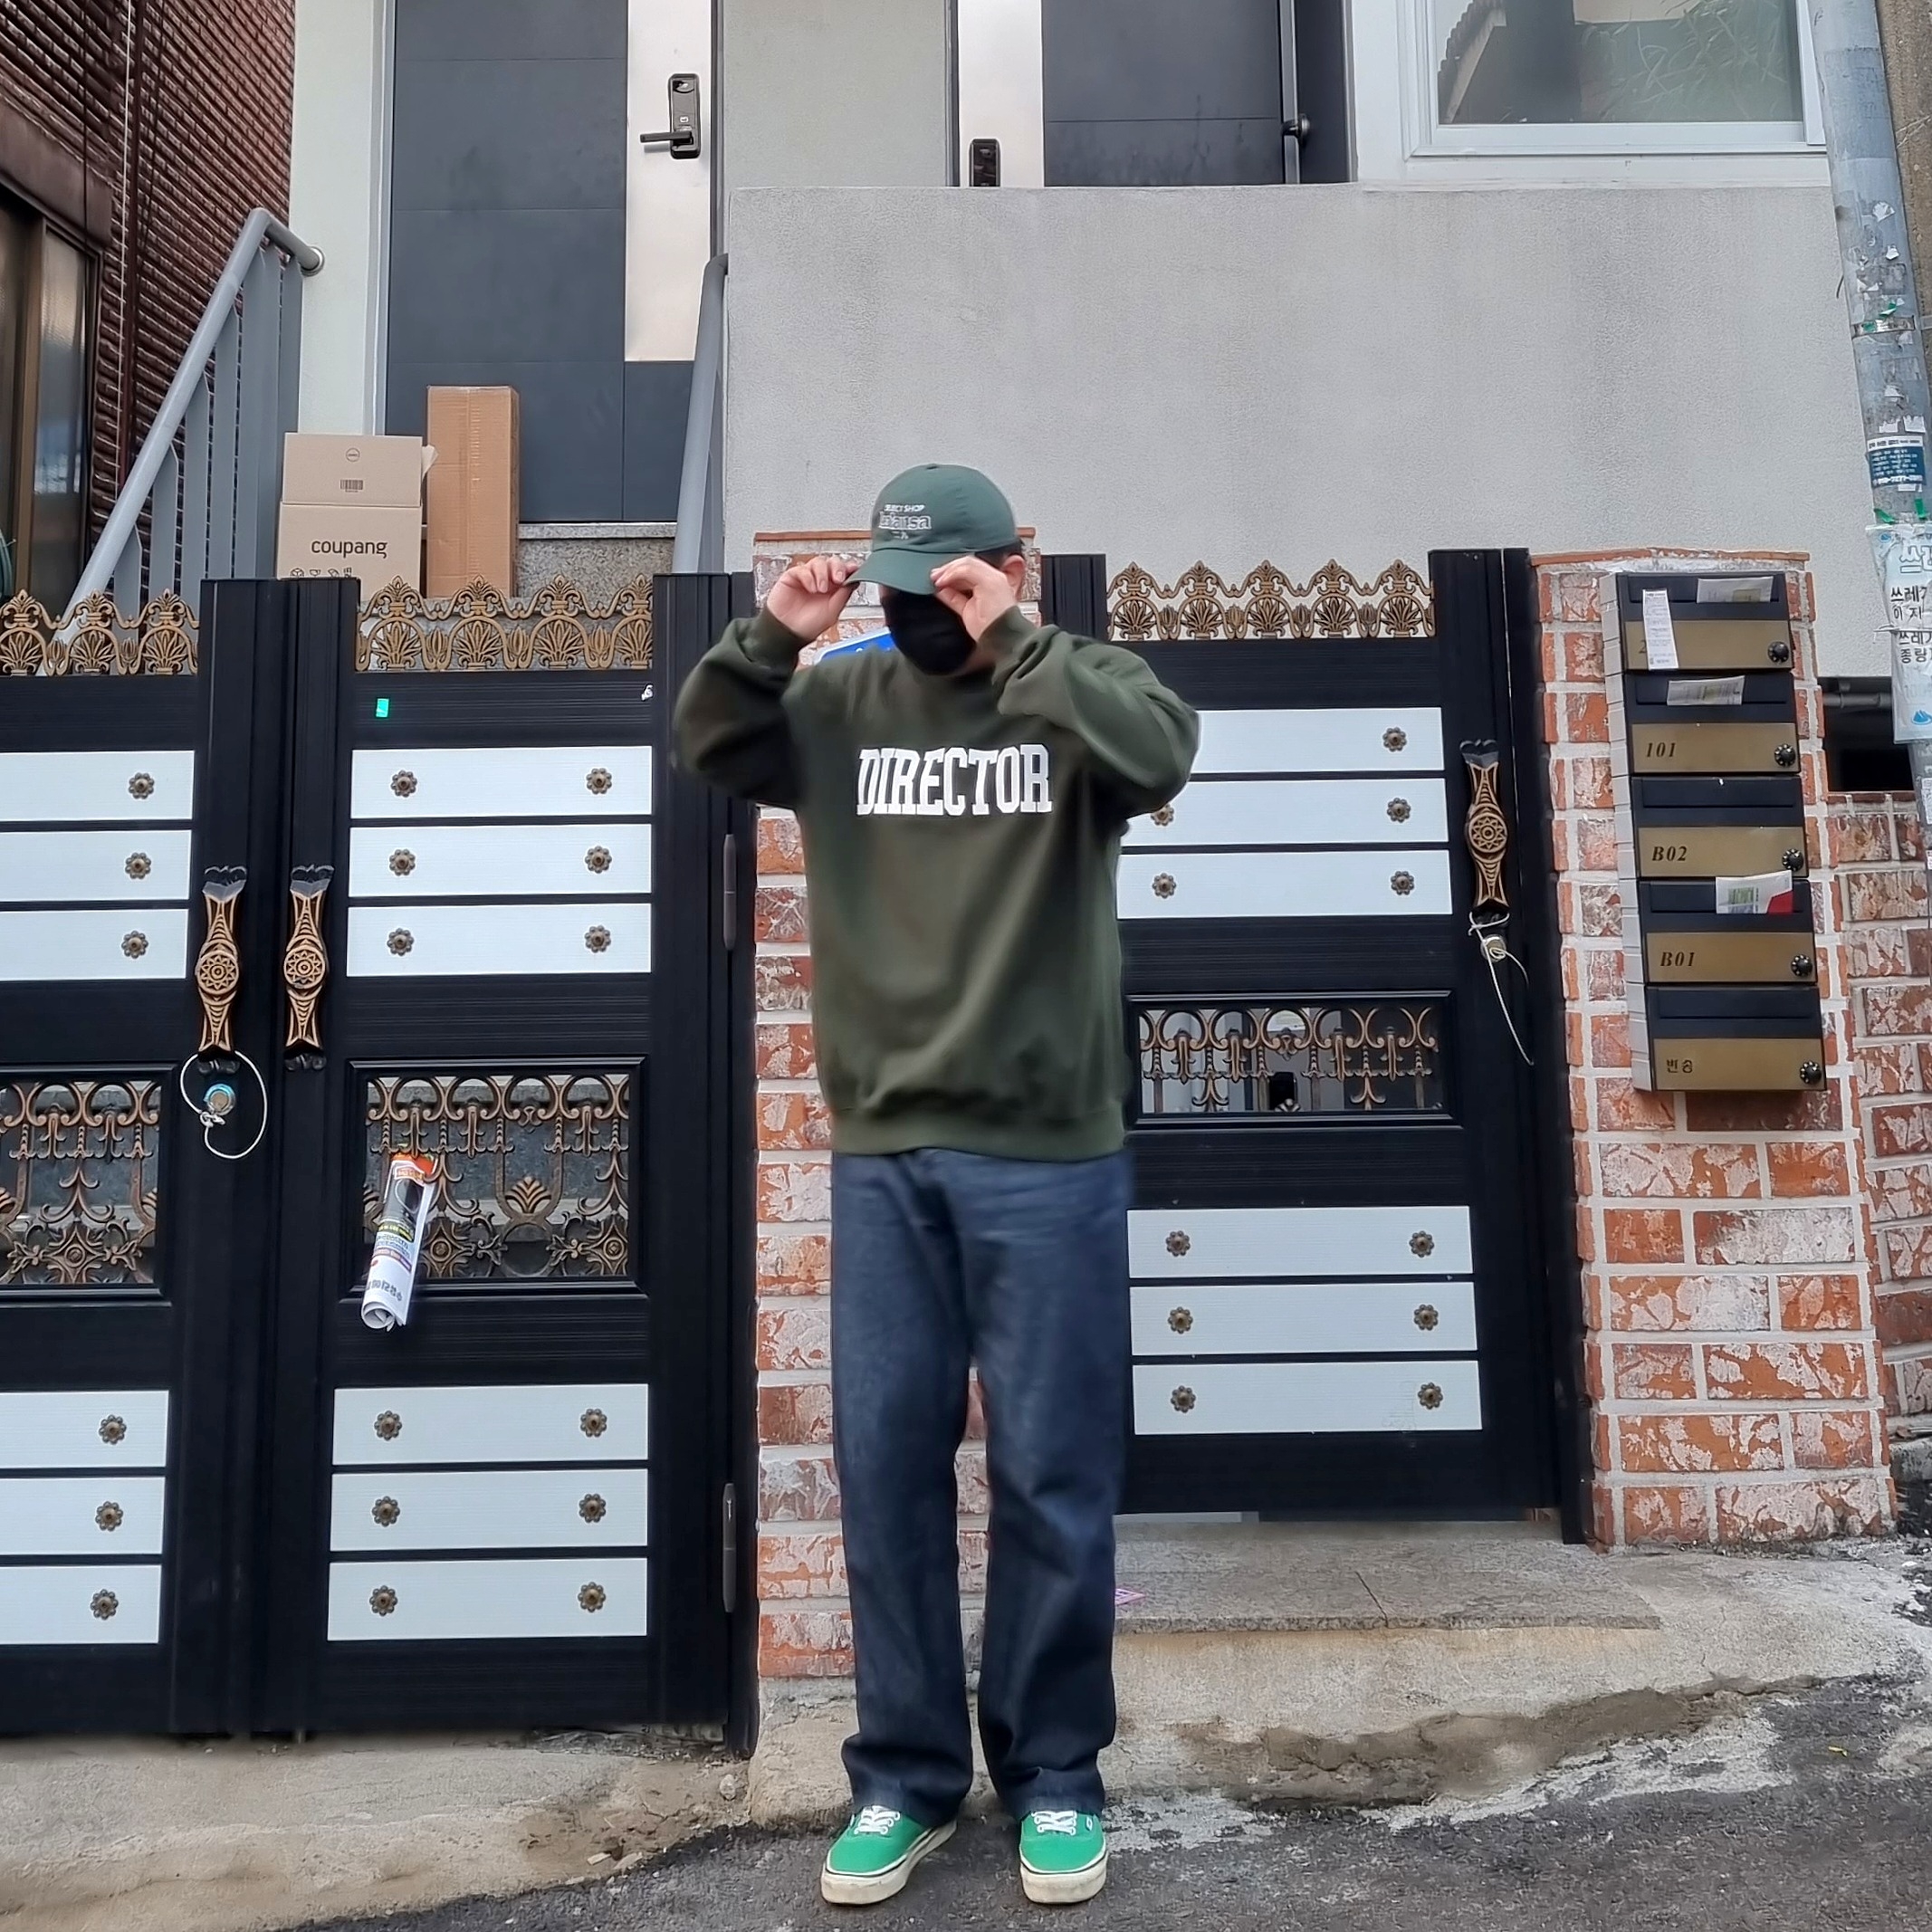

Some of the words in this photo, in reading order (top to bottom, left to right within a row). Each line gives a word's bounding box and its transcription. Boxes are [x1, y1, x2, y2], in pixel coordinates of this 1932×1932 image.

[311, 540, 387, 559] coupang
[1899, 647, 1932, 664] 종량
[1645, 741, 1677, 759] 101
[856, 743, 1052, 816] DIRECTOR
[1651, 845, 1688, 862] B02
[1659, 952, 1695, 967] B01
